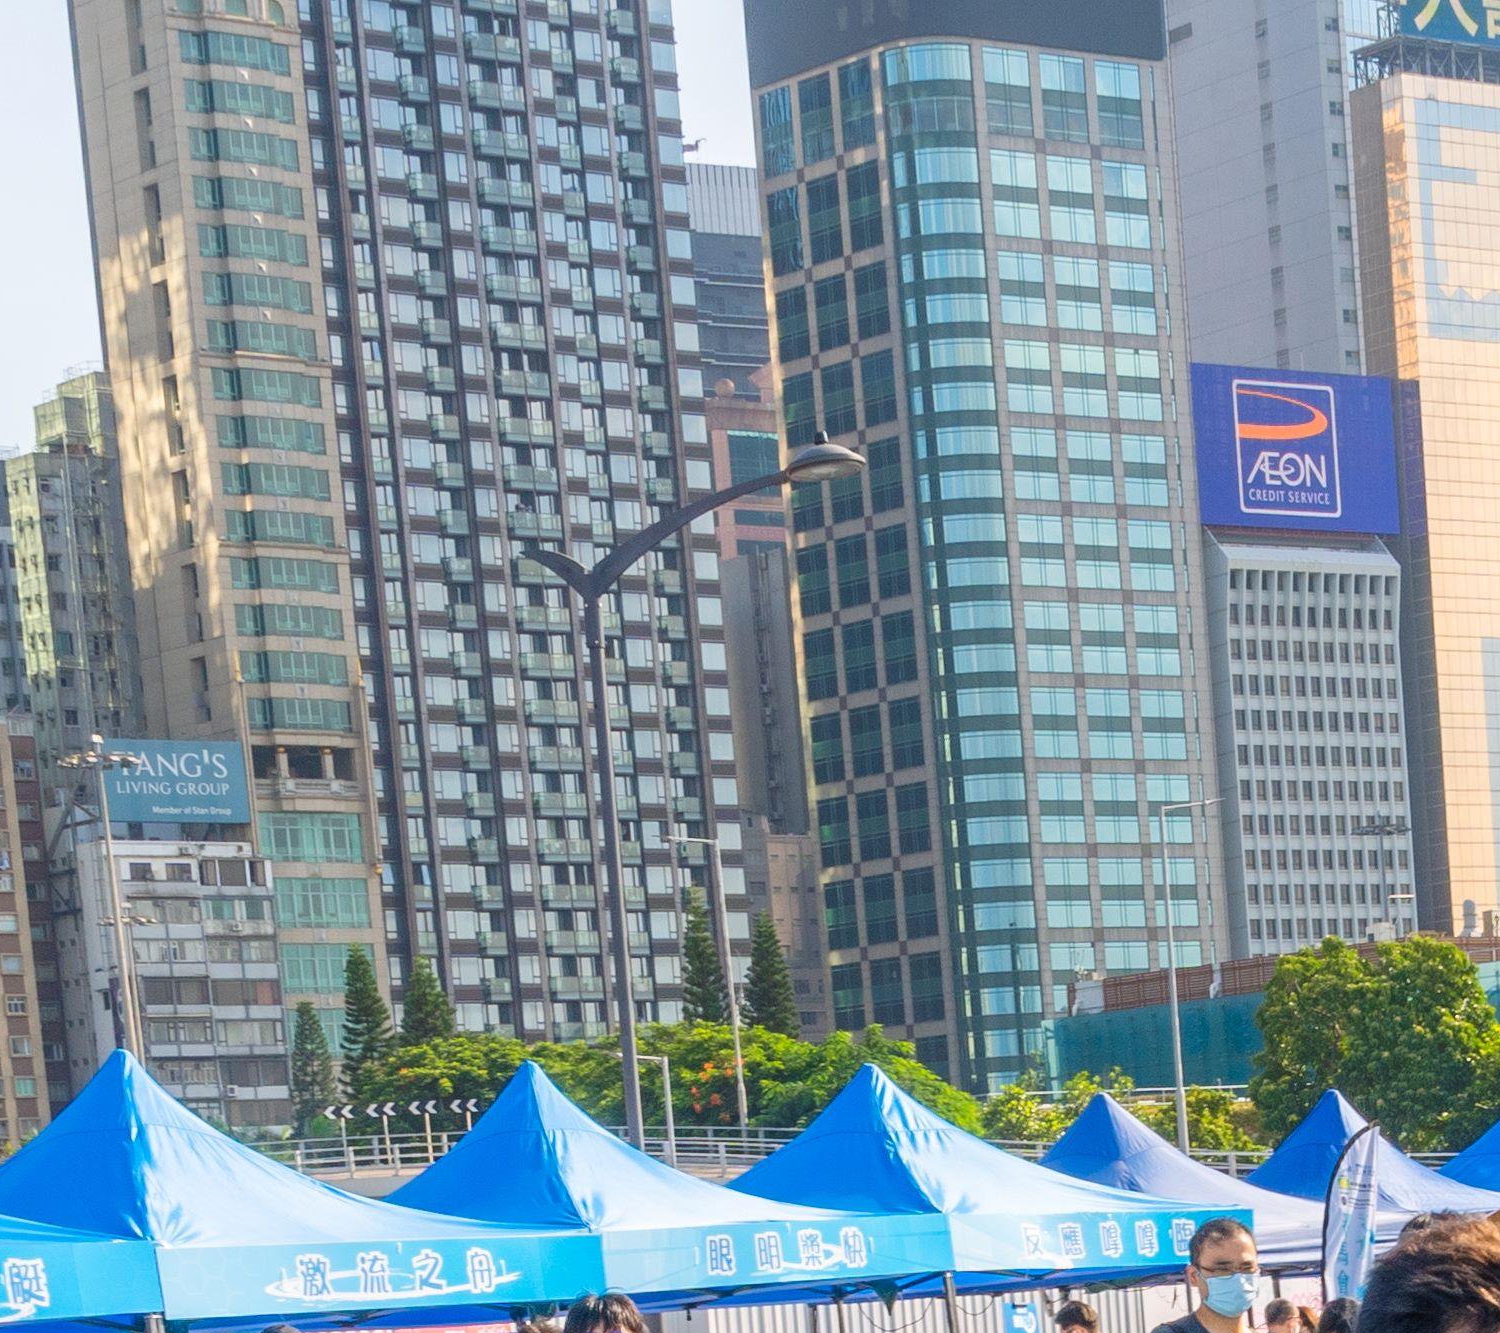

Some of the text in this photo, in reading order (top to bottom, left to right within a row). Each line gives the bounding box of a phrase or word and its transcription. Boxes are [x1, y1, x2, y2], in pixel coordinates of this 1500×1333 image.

[1248, 488, 1331, 505] CREDIT SERVICE
[117, 749, 228, 779] ANG'S
[116, 781, 230, 796] LIVING GROUP
[152, 806, 182, 815] Member
[211, 806, 232, 816] Group
